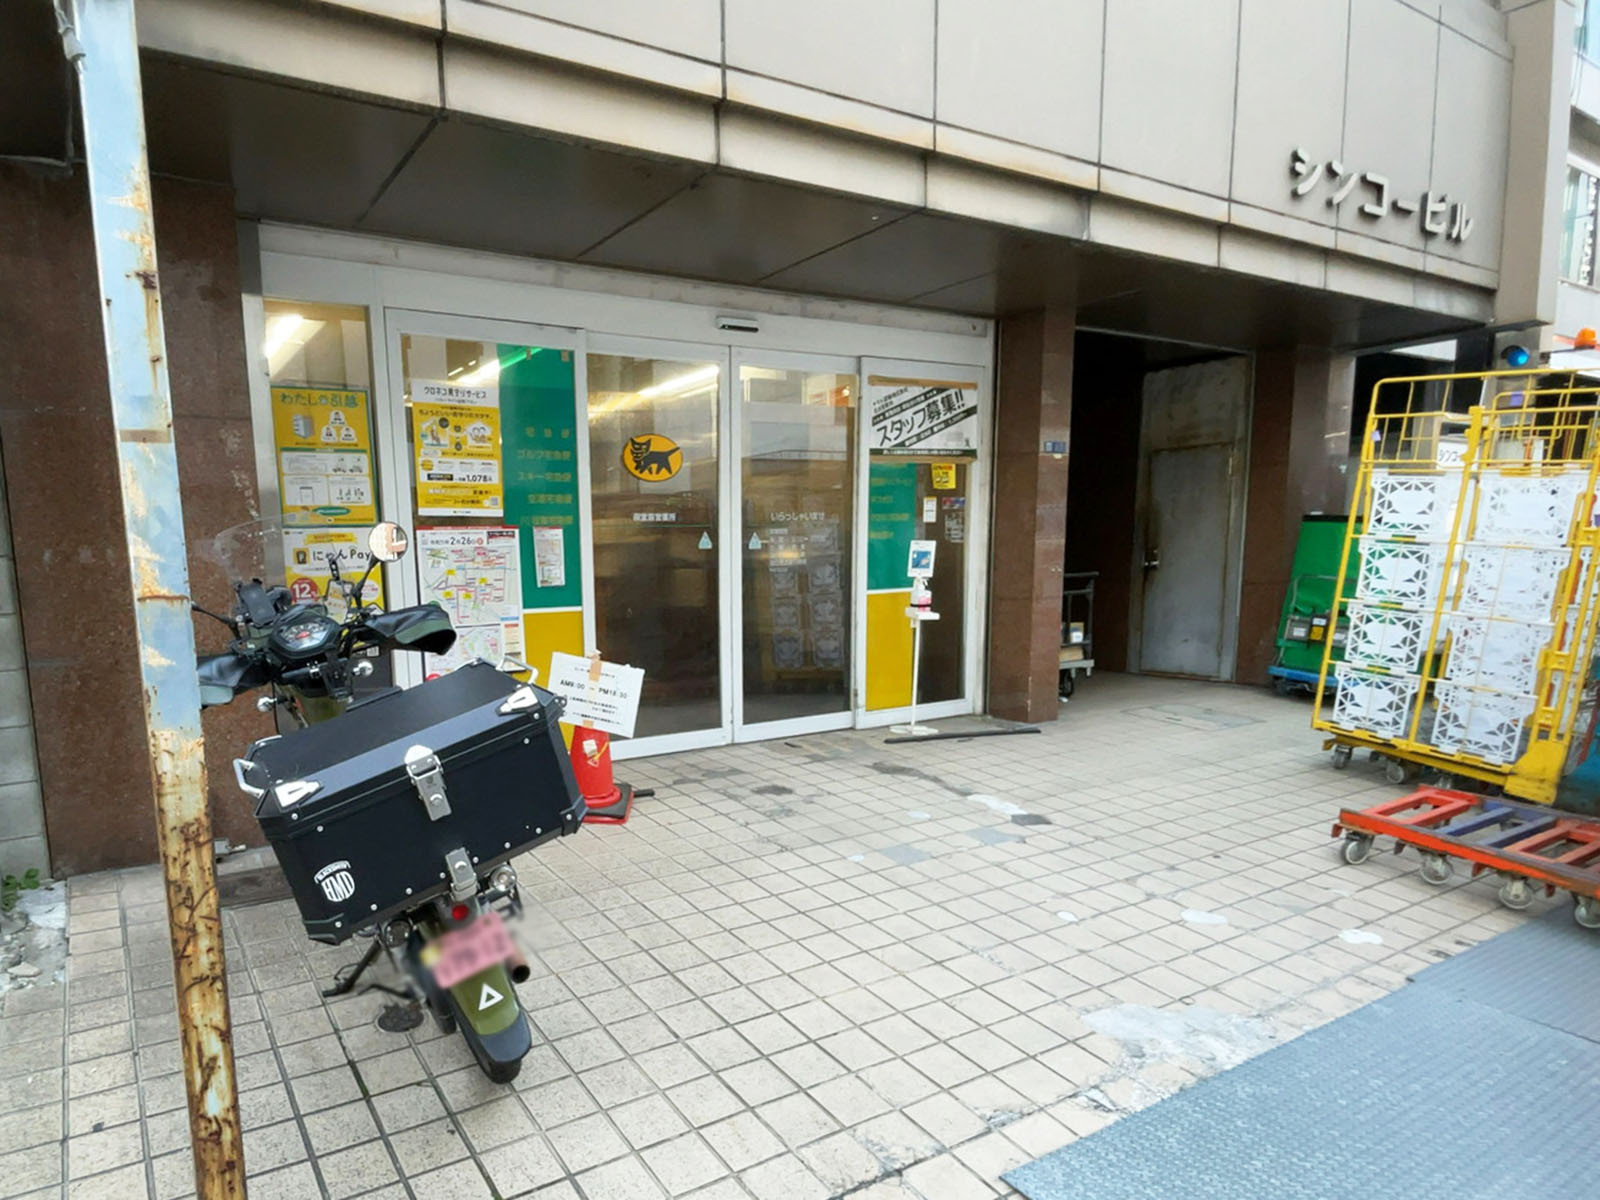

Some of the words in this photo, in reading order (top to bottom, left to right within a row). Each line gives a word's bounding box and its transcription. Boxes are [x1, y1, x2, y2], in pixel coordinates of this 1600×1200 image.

[1289, 147, 1475, 241] シンコービル
